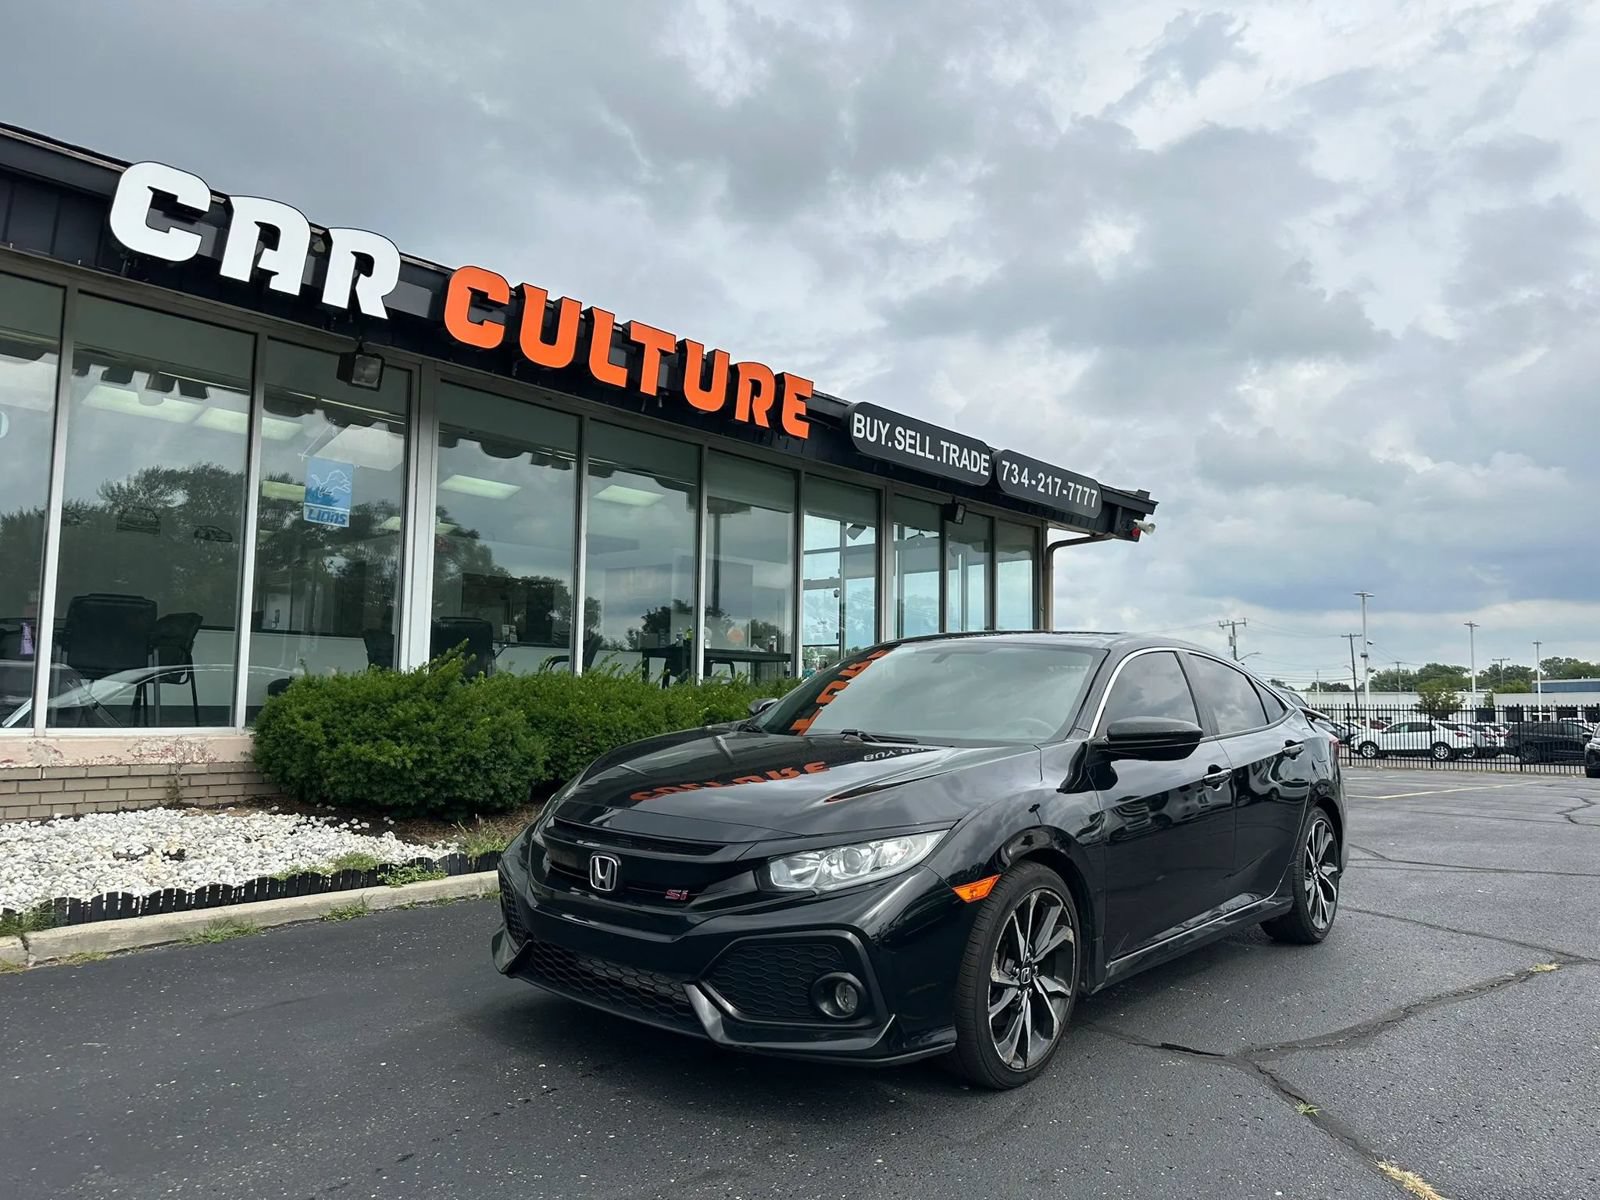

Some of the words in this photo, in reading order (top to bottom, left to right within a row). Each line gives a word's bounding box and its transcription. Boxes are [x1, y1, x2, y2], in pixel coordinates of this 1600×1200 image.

[109, 161, 401, 320] CAR
[444, 265, 814, 440] CULTURE
[1002, 460, 1098, 508] 734-217-7777
